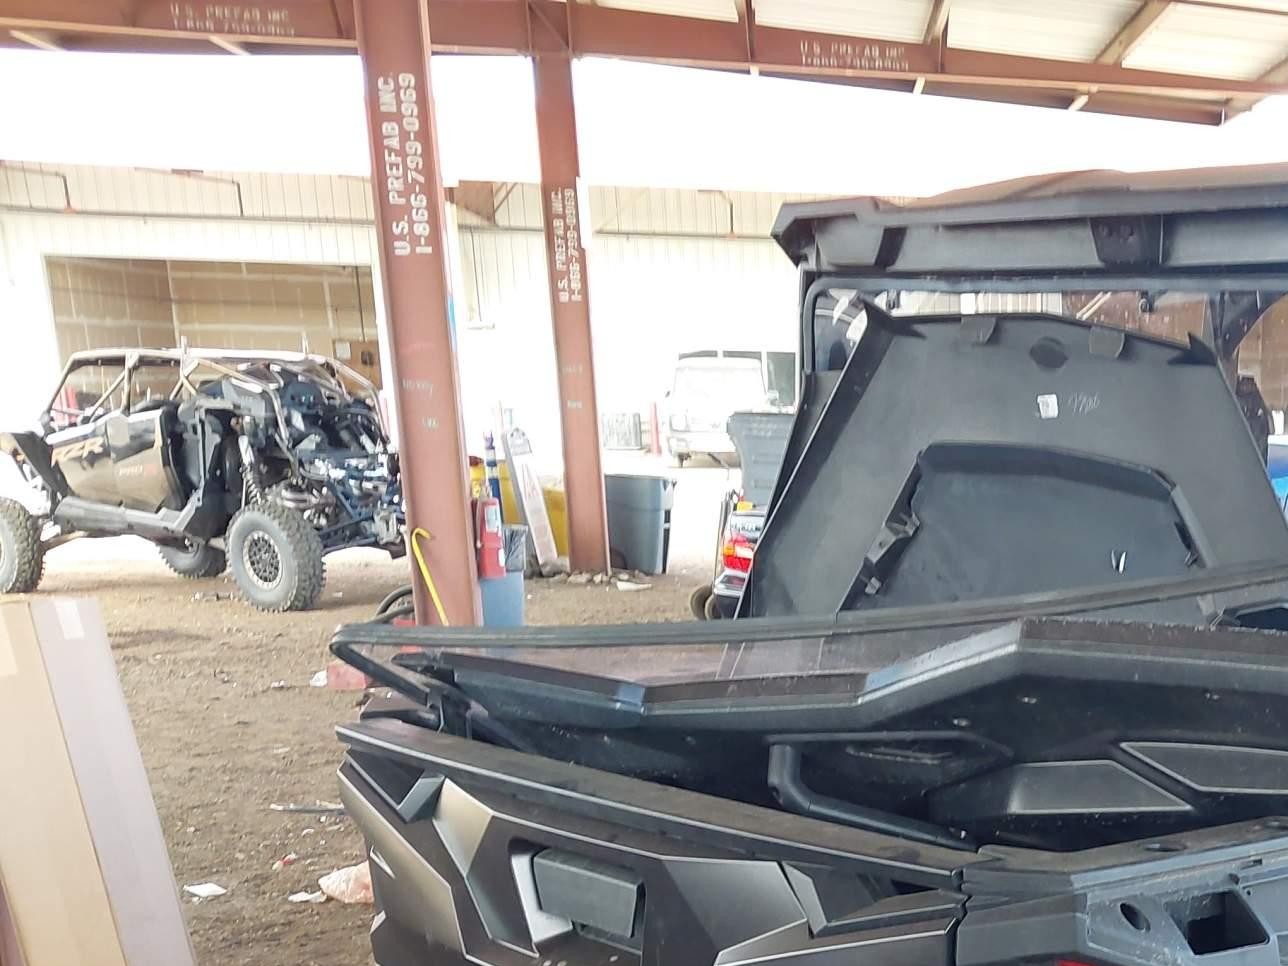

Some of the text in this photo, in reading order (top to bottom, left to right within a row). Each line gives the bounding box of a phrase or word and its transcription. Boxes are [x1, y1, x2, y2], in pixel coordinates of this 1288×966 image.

[382, 121, 407, 205] PREFAB
[398, 72, 433, 254] 1-866-799-0969
[392, 215, 411, 256] U.S.
[553, 218, 567, 271] PREFAB
